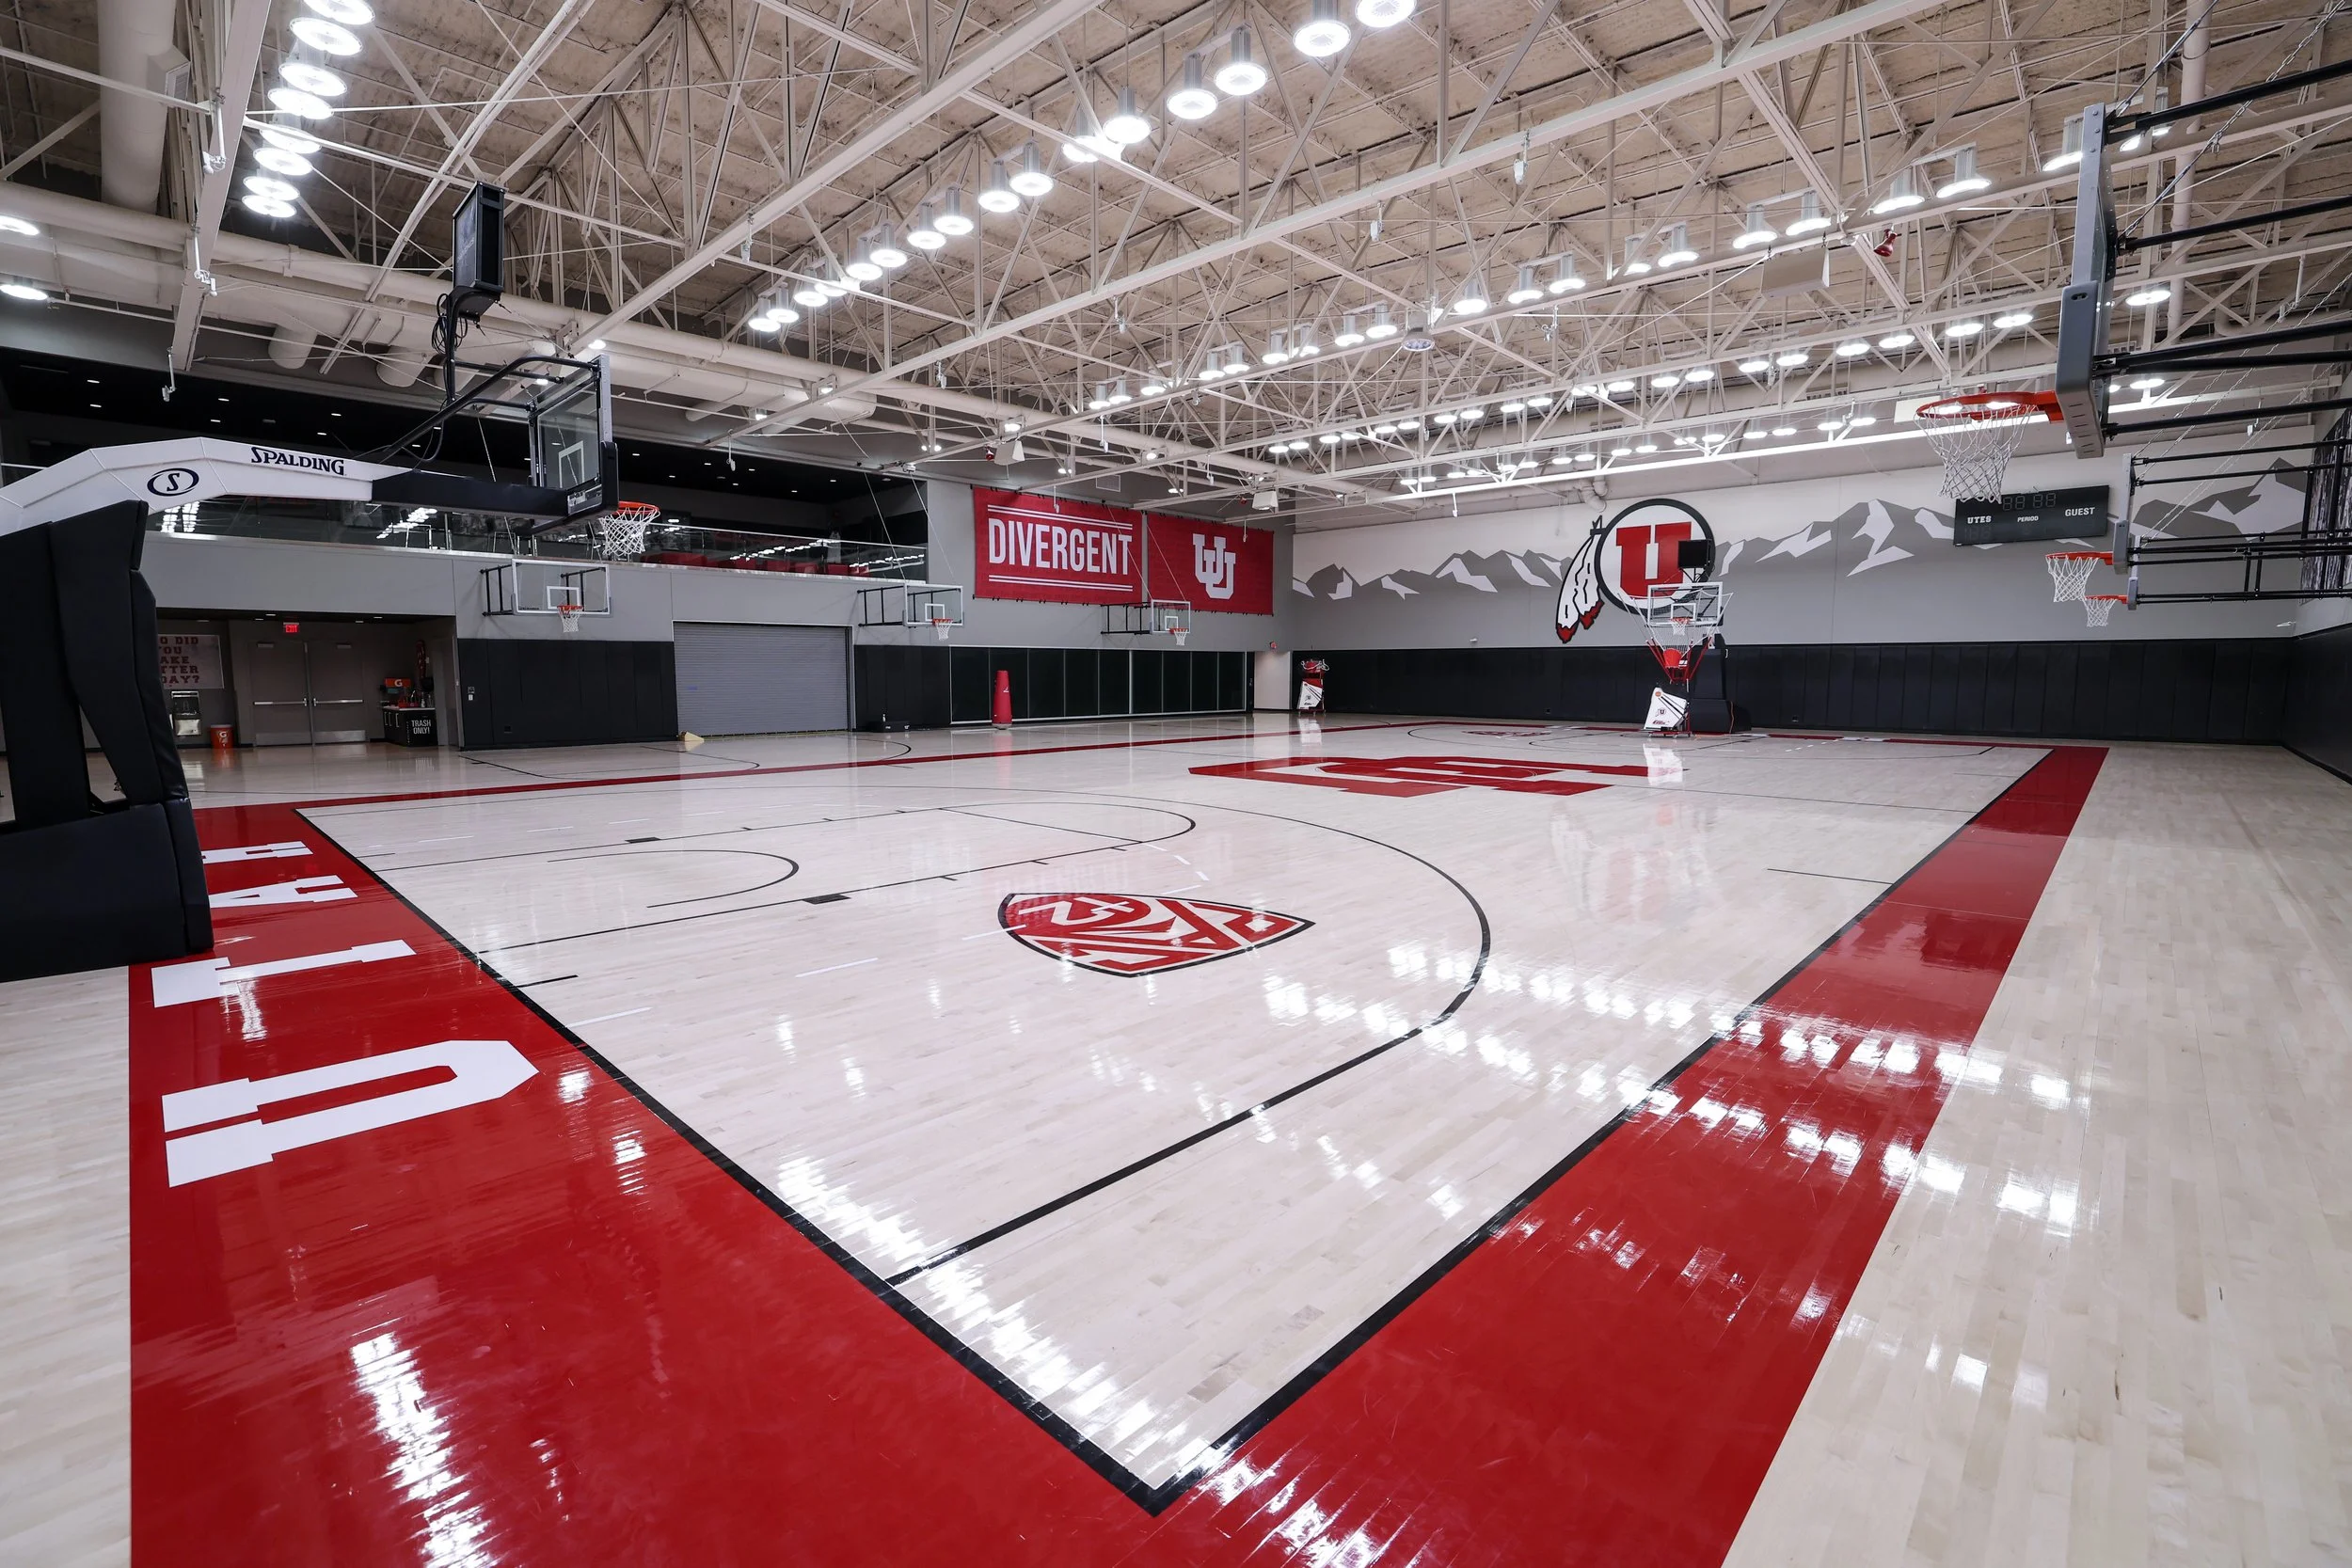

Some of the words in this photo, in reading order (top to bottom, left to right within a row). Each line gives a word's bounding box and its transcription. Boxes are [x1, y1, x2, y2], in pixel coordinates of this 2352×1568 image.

[251, 446, 344, 476] SPALDING
[167, 472, 180, 492] S
[1967, 515, 1992, 524] UTES
[2065, 507, 2095, 517] GUEST
[989, 517, 1133, 576] DIVERGENT
[1616, 521, 1692, 600] U
[285, 625, 298, 633] EXIT
[175, 637, 199, 645] DID
